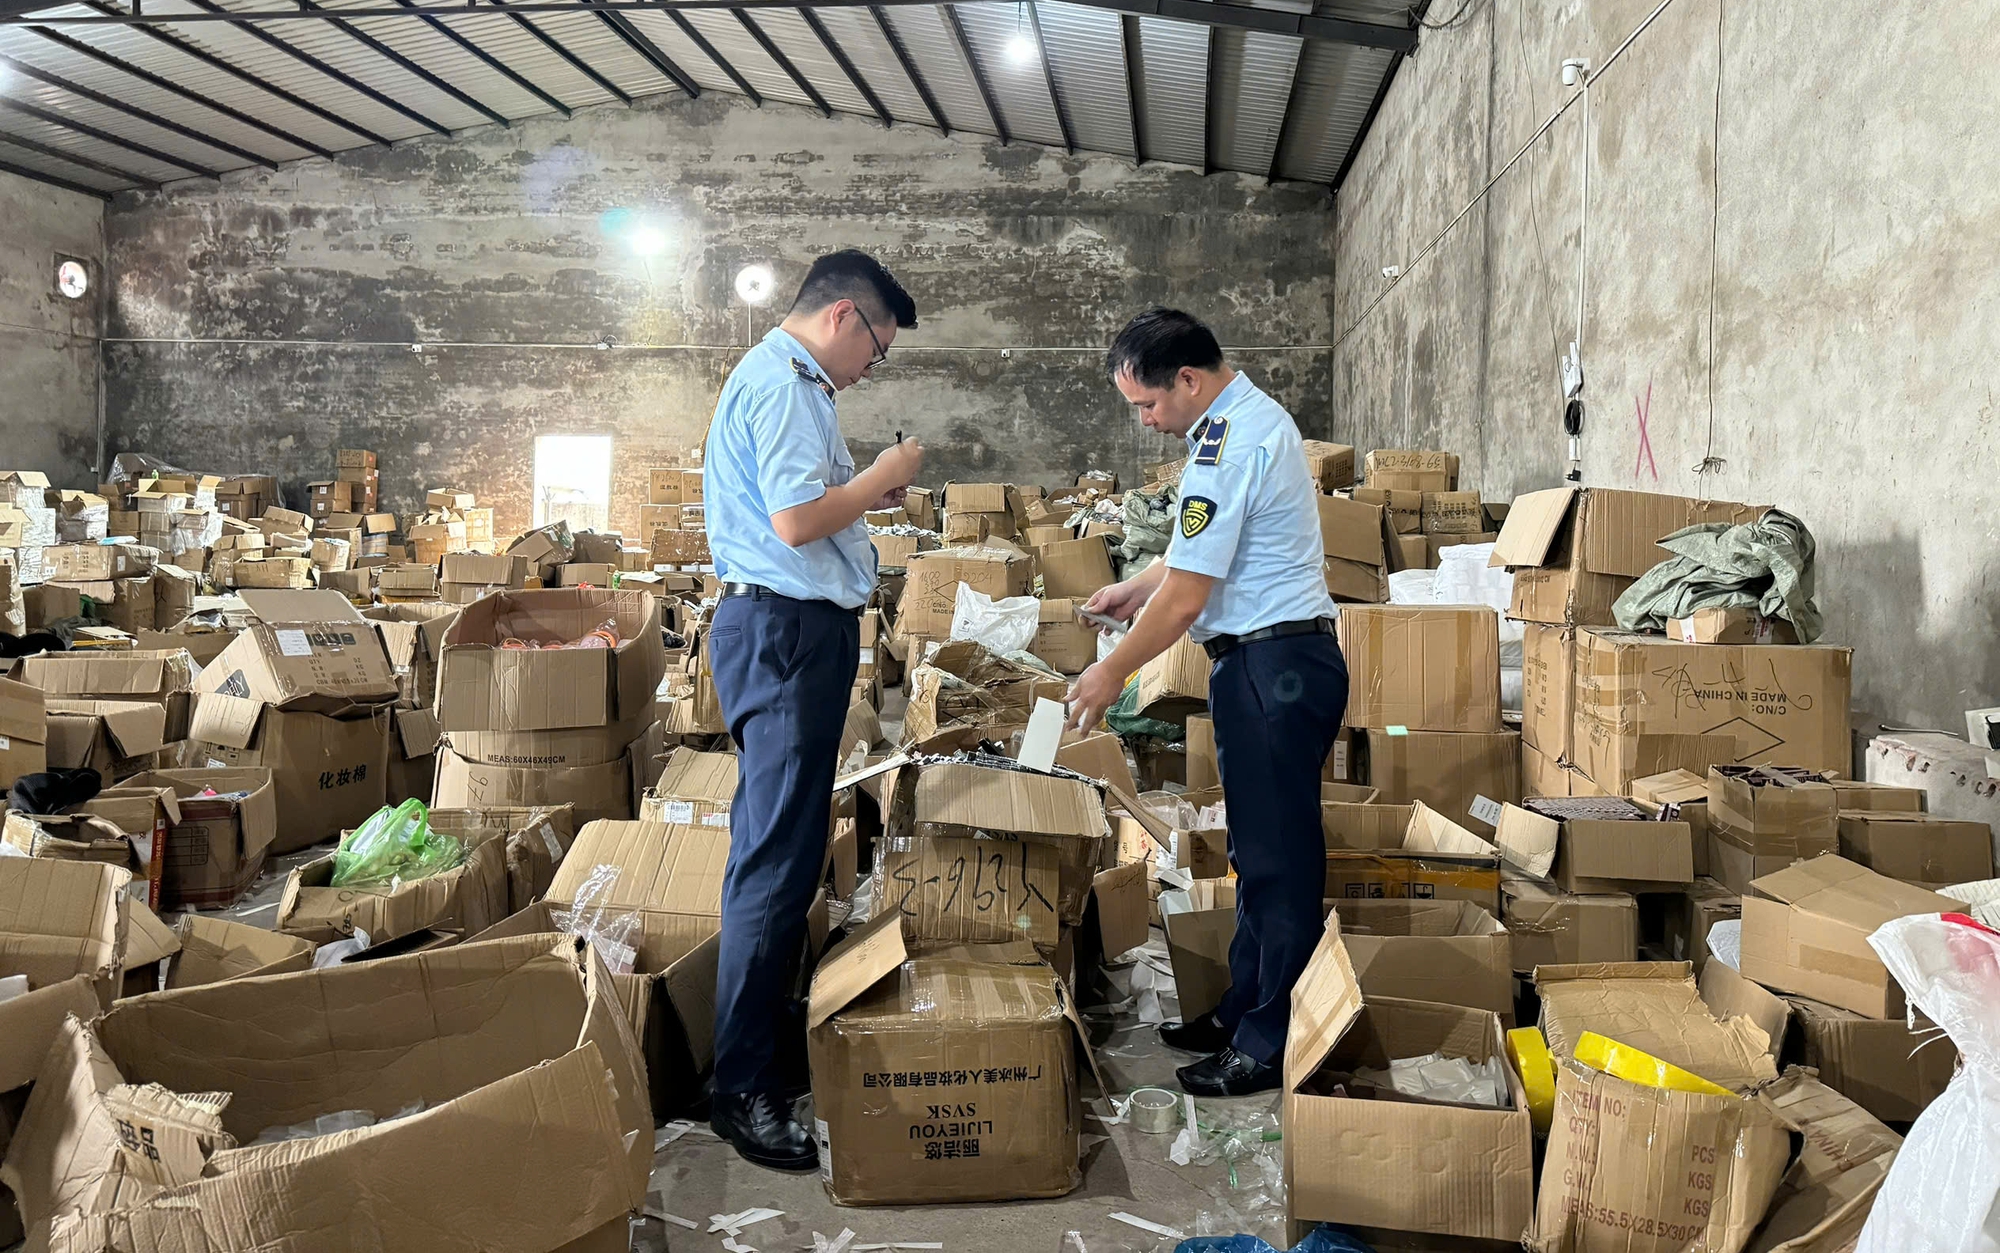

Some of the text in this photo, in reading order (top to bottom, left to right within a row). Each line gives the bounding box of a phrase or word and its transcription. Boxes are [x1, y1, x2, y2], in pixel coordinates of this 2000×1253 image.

[1189, 500, 1208, 511] DMS
[964, 571, 993, 585] 2204
[1695, 690, 1787, 702] MADE IN CHINA
[1752, 704, 1787, 715] C/NO:
[487, 754, 566, 764] MEAS:60X46X49CM
[318, 763, 367, 790] 化妆棉
[863, 1065, 1042, 1088] 广州冰美人化妆品有限公司
[926, 1103, 976, 1119] SVSK
[1572, 1089, 1626, 1121] ITEM NO:
[909, 1121, 993, 1139] LIJIEYOU
[1569, 1116, 1596, 1137] QTY:
[924, 1138, 980, 1160] 丽洁悠
[1691, 1145, 1715, 1165] PCS
[1688, 1171, 1712, 1191] KGS
[1683, 1197, 1709, 1218] KGS
